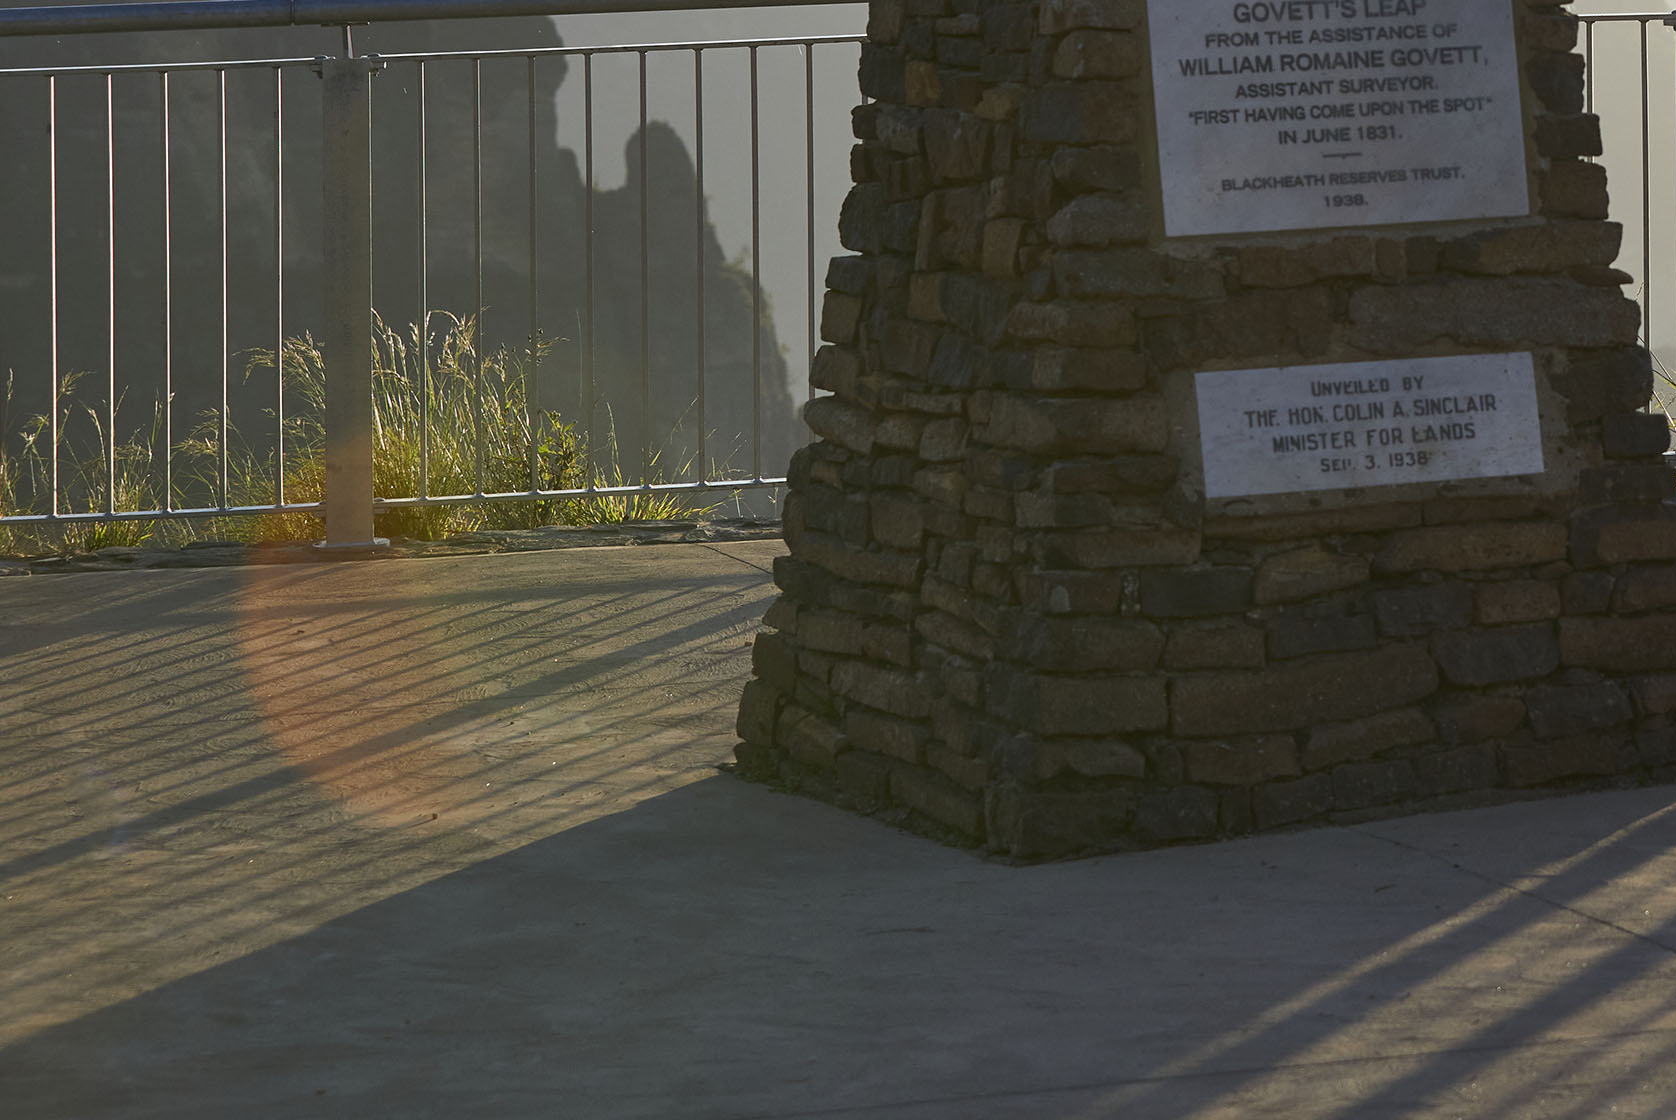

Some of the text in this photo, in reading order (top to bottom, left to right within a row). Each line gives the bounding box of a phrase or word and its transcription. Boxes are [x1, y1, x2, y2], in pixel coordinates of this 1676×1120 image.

[1205, 24, 1457, 48] FROM THE ASSISTANCE OF
[1179, 45, 1489, 76] WILLIAM ROMAINE GOVETT,
[1235, 81, 1334, 99] ASSISTANT
[1244, 106, 1305, 122] HAVING
[1310, 103, 1355, 119] COME
[1358, 101, 1405, 117] UPON
[1408, 100, 1439, 114] THE
[1278, 126, 1403, 144] IN JUNE 1831.
[1221, 167, 1465, 191] BLACKHEATH RESERVES TRUST.
[1324, 194, 1368, 208] 1938.
[1403, 376, 1425, 390] BY
[1333, 401, 1385, 423] COLIN
[1393, 402, 1410, 418] A.
[1414, 394, 1497, 416] SINCLAIR
[1273, 422, 1476, 453] MINISTER FOR LANDS
